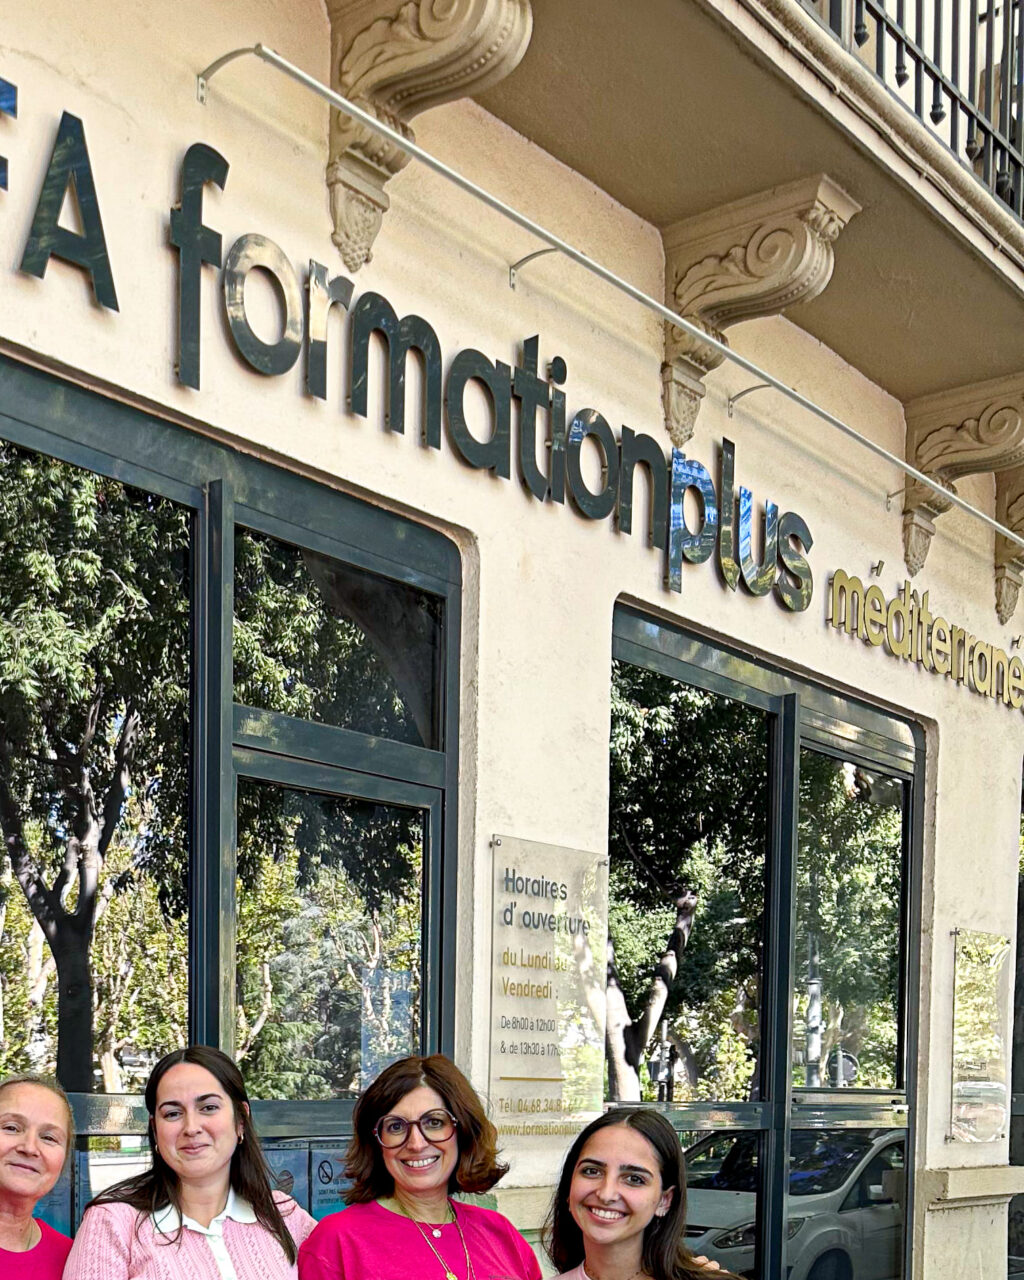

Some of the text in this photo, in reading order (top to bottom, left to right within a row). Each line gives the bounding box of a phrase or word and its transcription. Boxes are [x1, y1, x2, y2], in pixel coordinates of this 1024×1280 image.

[171, 142, 814, 612] formationplus
[505, 868, 568, 900] Horaires
[502, 947, 516, 966] du
[520, 948, 552, 969] Lundi
[502, 977, 552, 999] Vendredi
[501, 1016, 556, 1032] De 8h00 à 12h00
[500, 1041, 507, 1054] &
[509, 1043, 518, 1055] de
[520, 1042, 540, 1055] 13h30
[540, 1044, 546, 1056] à
